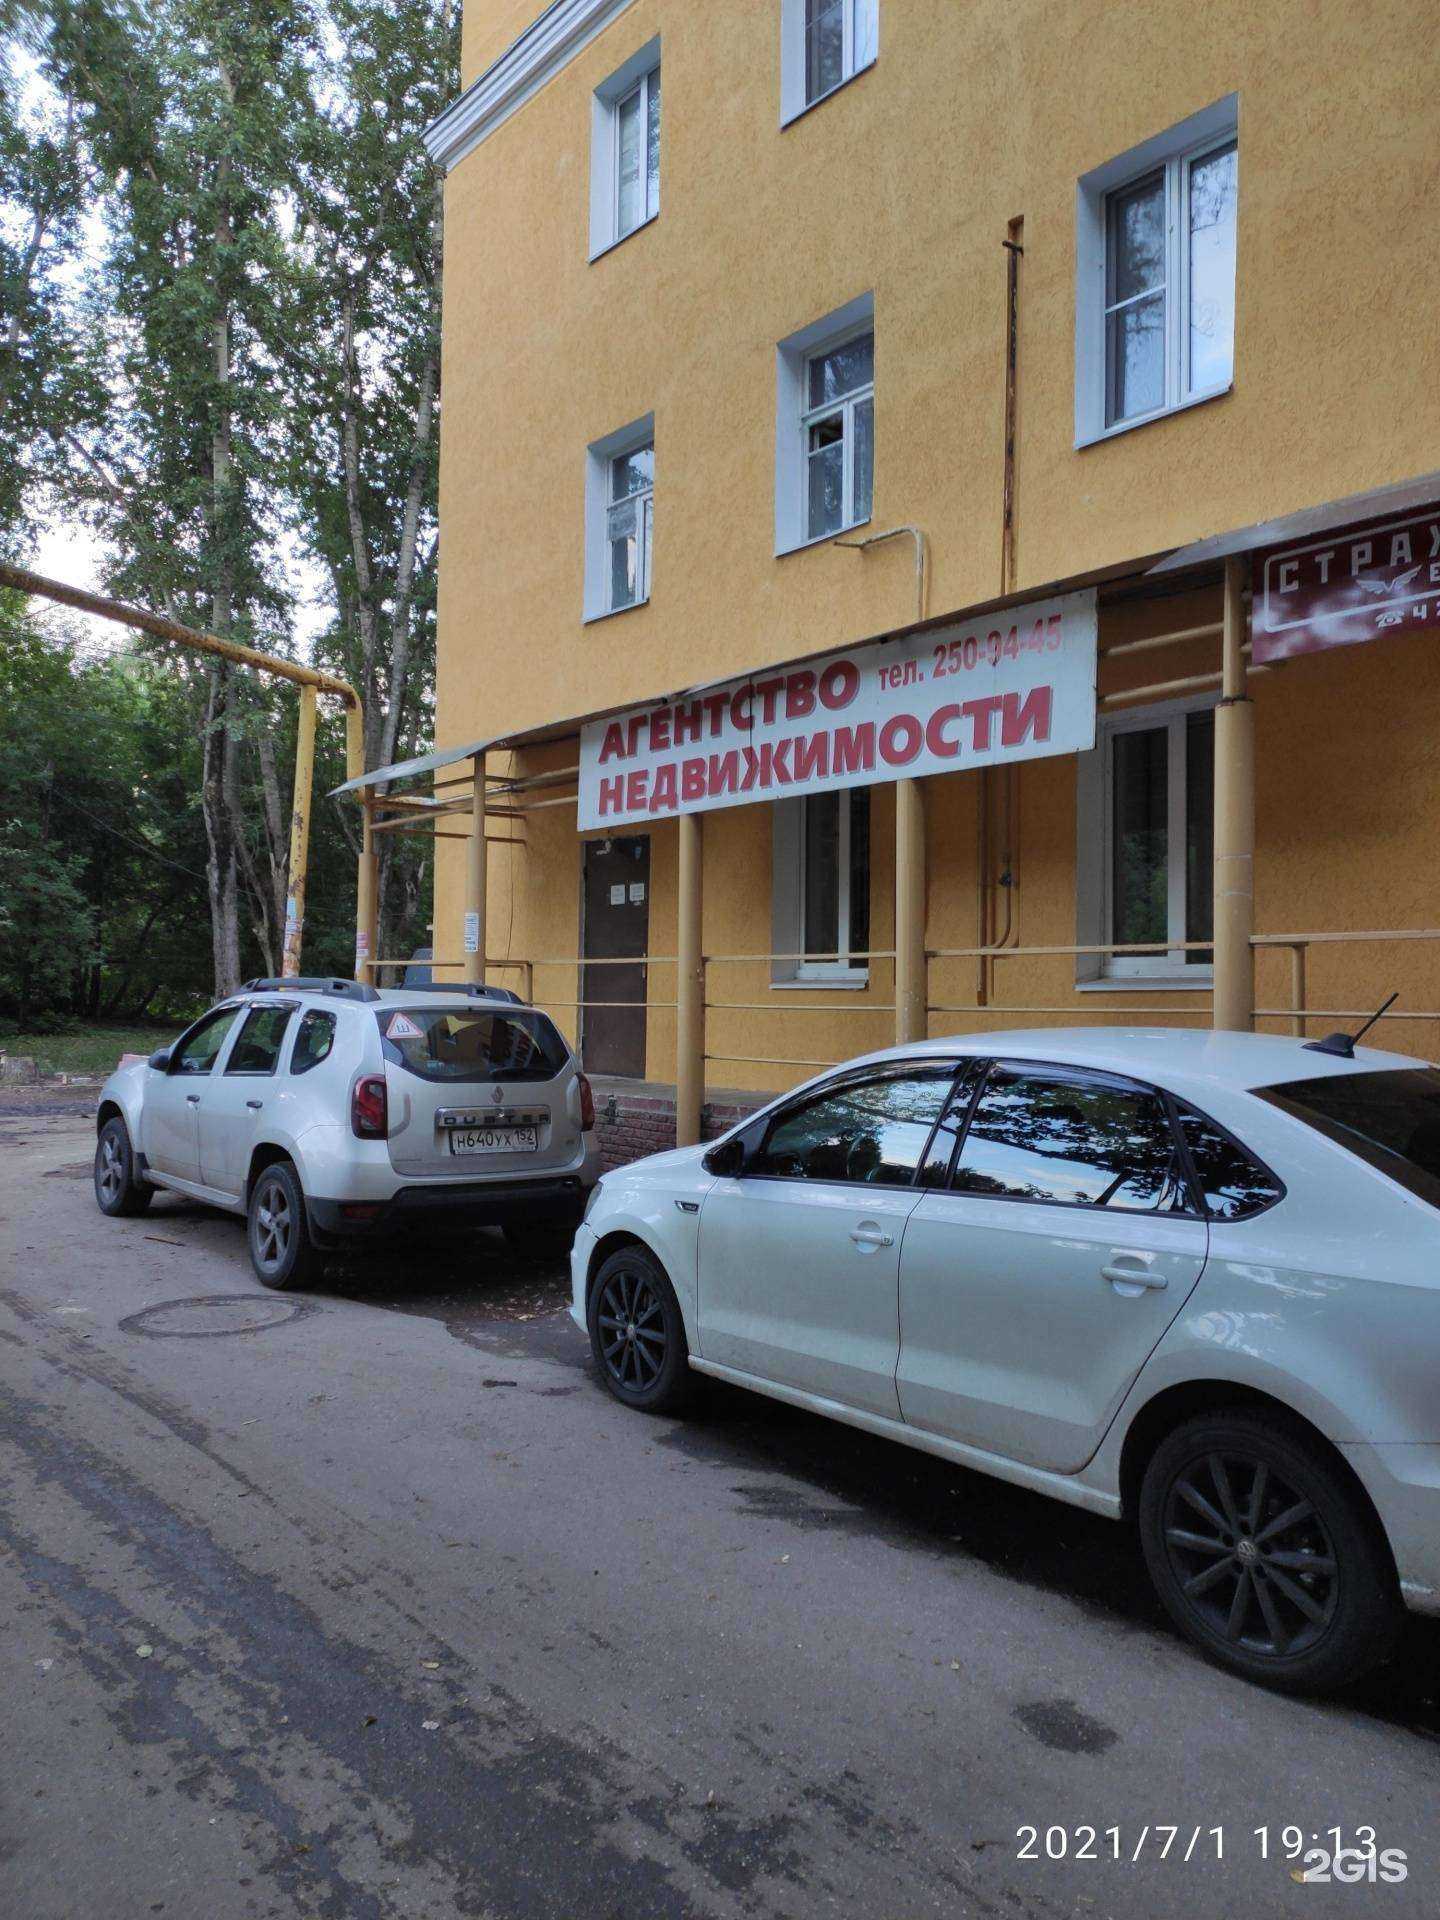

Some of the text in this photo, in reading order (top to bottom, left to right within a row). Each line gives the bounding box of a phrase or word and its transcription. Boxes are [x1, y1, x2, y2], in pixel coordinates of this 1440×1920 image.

[878, 613, 1062, 691] тел. 250-94-45
[598, 659, 861, 765] АГЕНТСТВО
[598, 685, 1053, 817] НЕДВИЖИМОСТИ
[444, 1113, 549, 1125] DUSTER
[514, 1127, 533, 1144] 152
